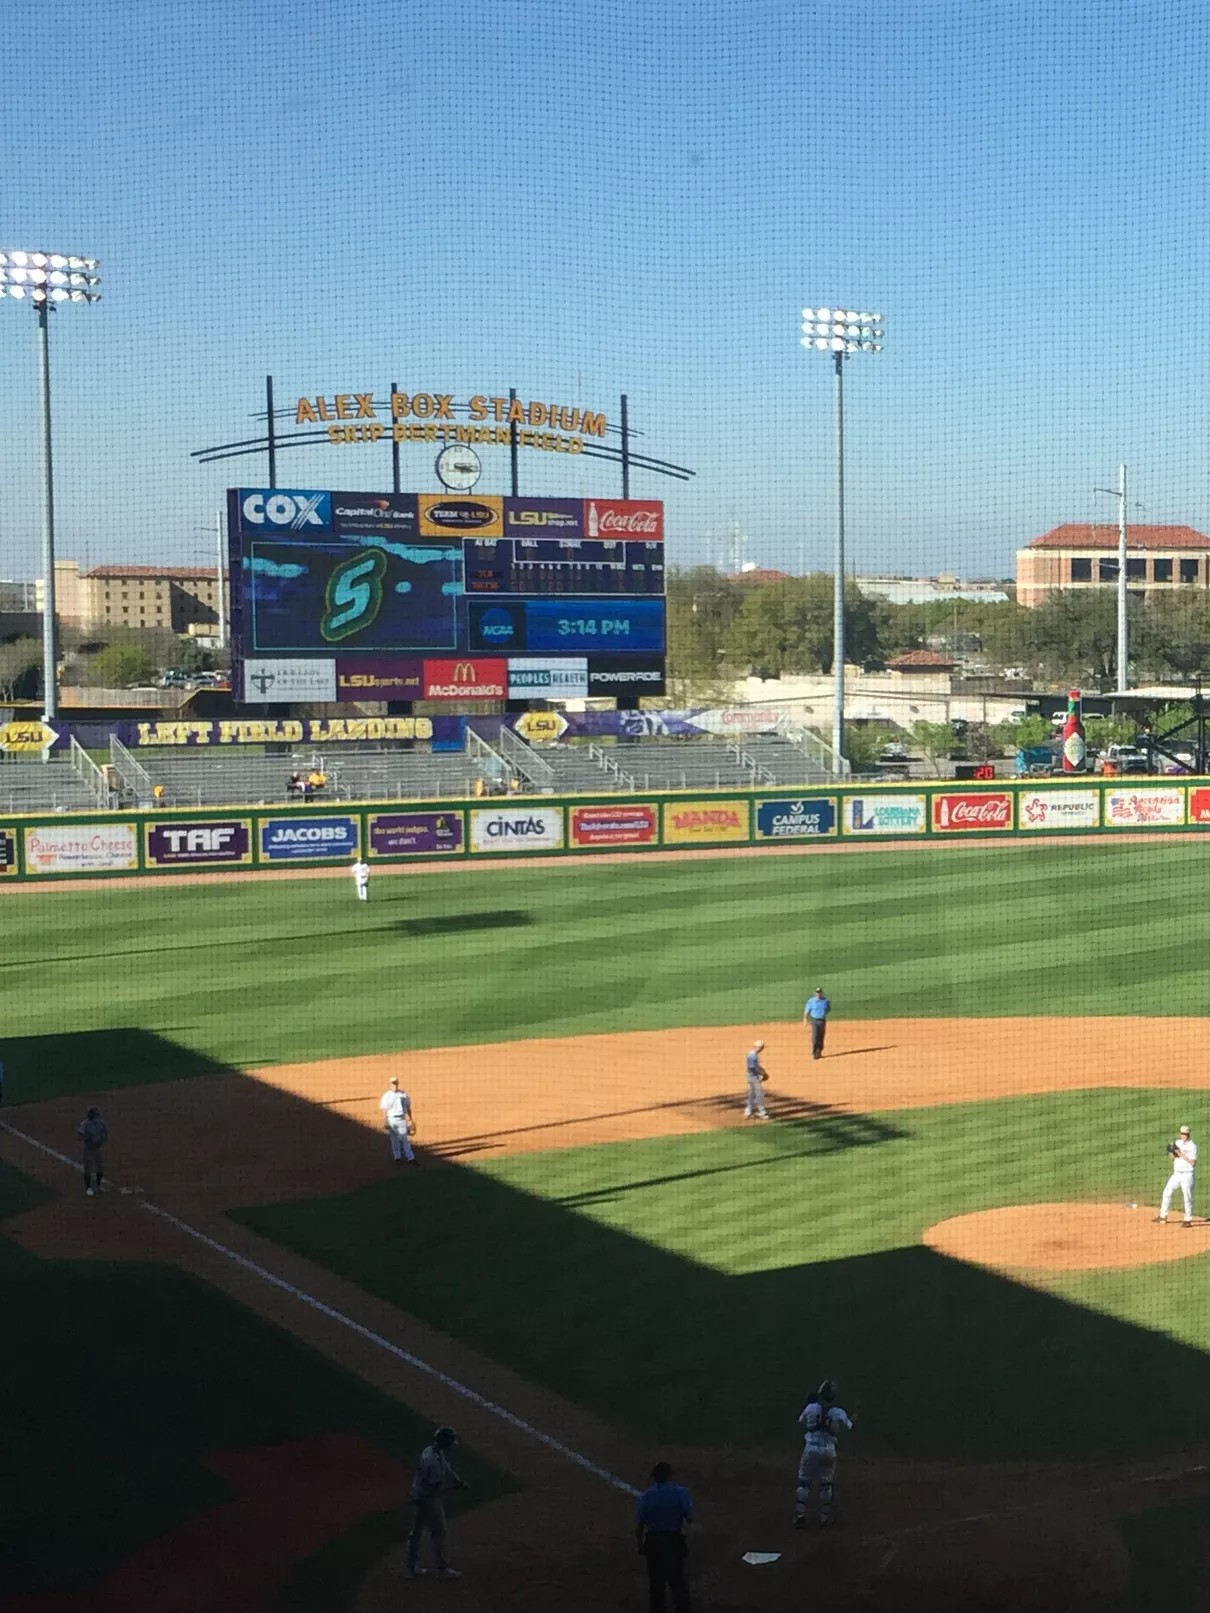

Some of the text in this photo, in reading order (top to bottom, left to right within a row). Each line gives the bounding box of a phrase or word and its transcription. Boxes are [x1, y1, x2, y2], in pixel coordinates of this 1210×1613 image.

[295, 392, 607, 438] ALEX BOX STADIUM
[327, 422, 584, 454] SKIP BERTMAN FIELD
[242, 493, 326, 530] COX
[508, 510, 548, 526] LSU
[483, 625, 514, 636] NCAA
[558, 619, 630, 635] 3:14 PM
[509, 671, 550, 685] PEOPLES
[428, 684, 503, 696] McDonald's
[137, 717, 433, 746] LEFT FIELD LANDING
[527, 719, 556, 732] LSU
[5, 730, 43, 744] LSU
[1050, 802, 1095, 811] REPUBLIC
[772, 814, 820, 826] CAMPUS
[271, 826, 348, 843] JACOBS
[772, 825, 820, 836] FEDERAL
[30, 835, 133, 853] Palmetto Cheese
[163, 828, 235, 852] TAF
